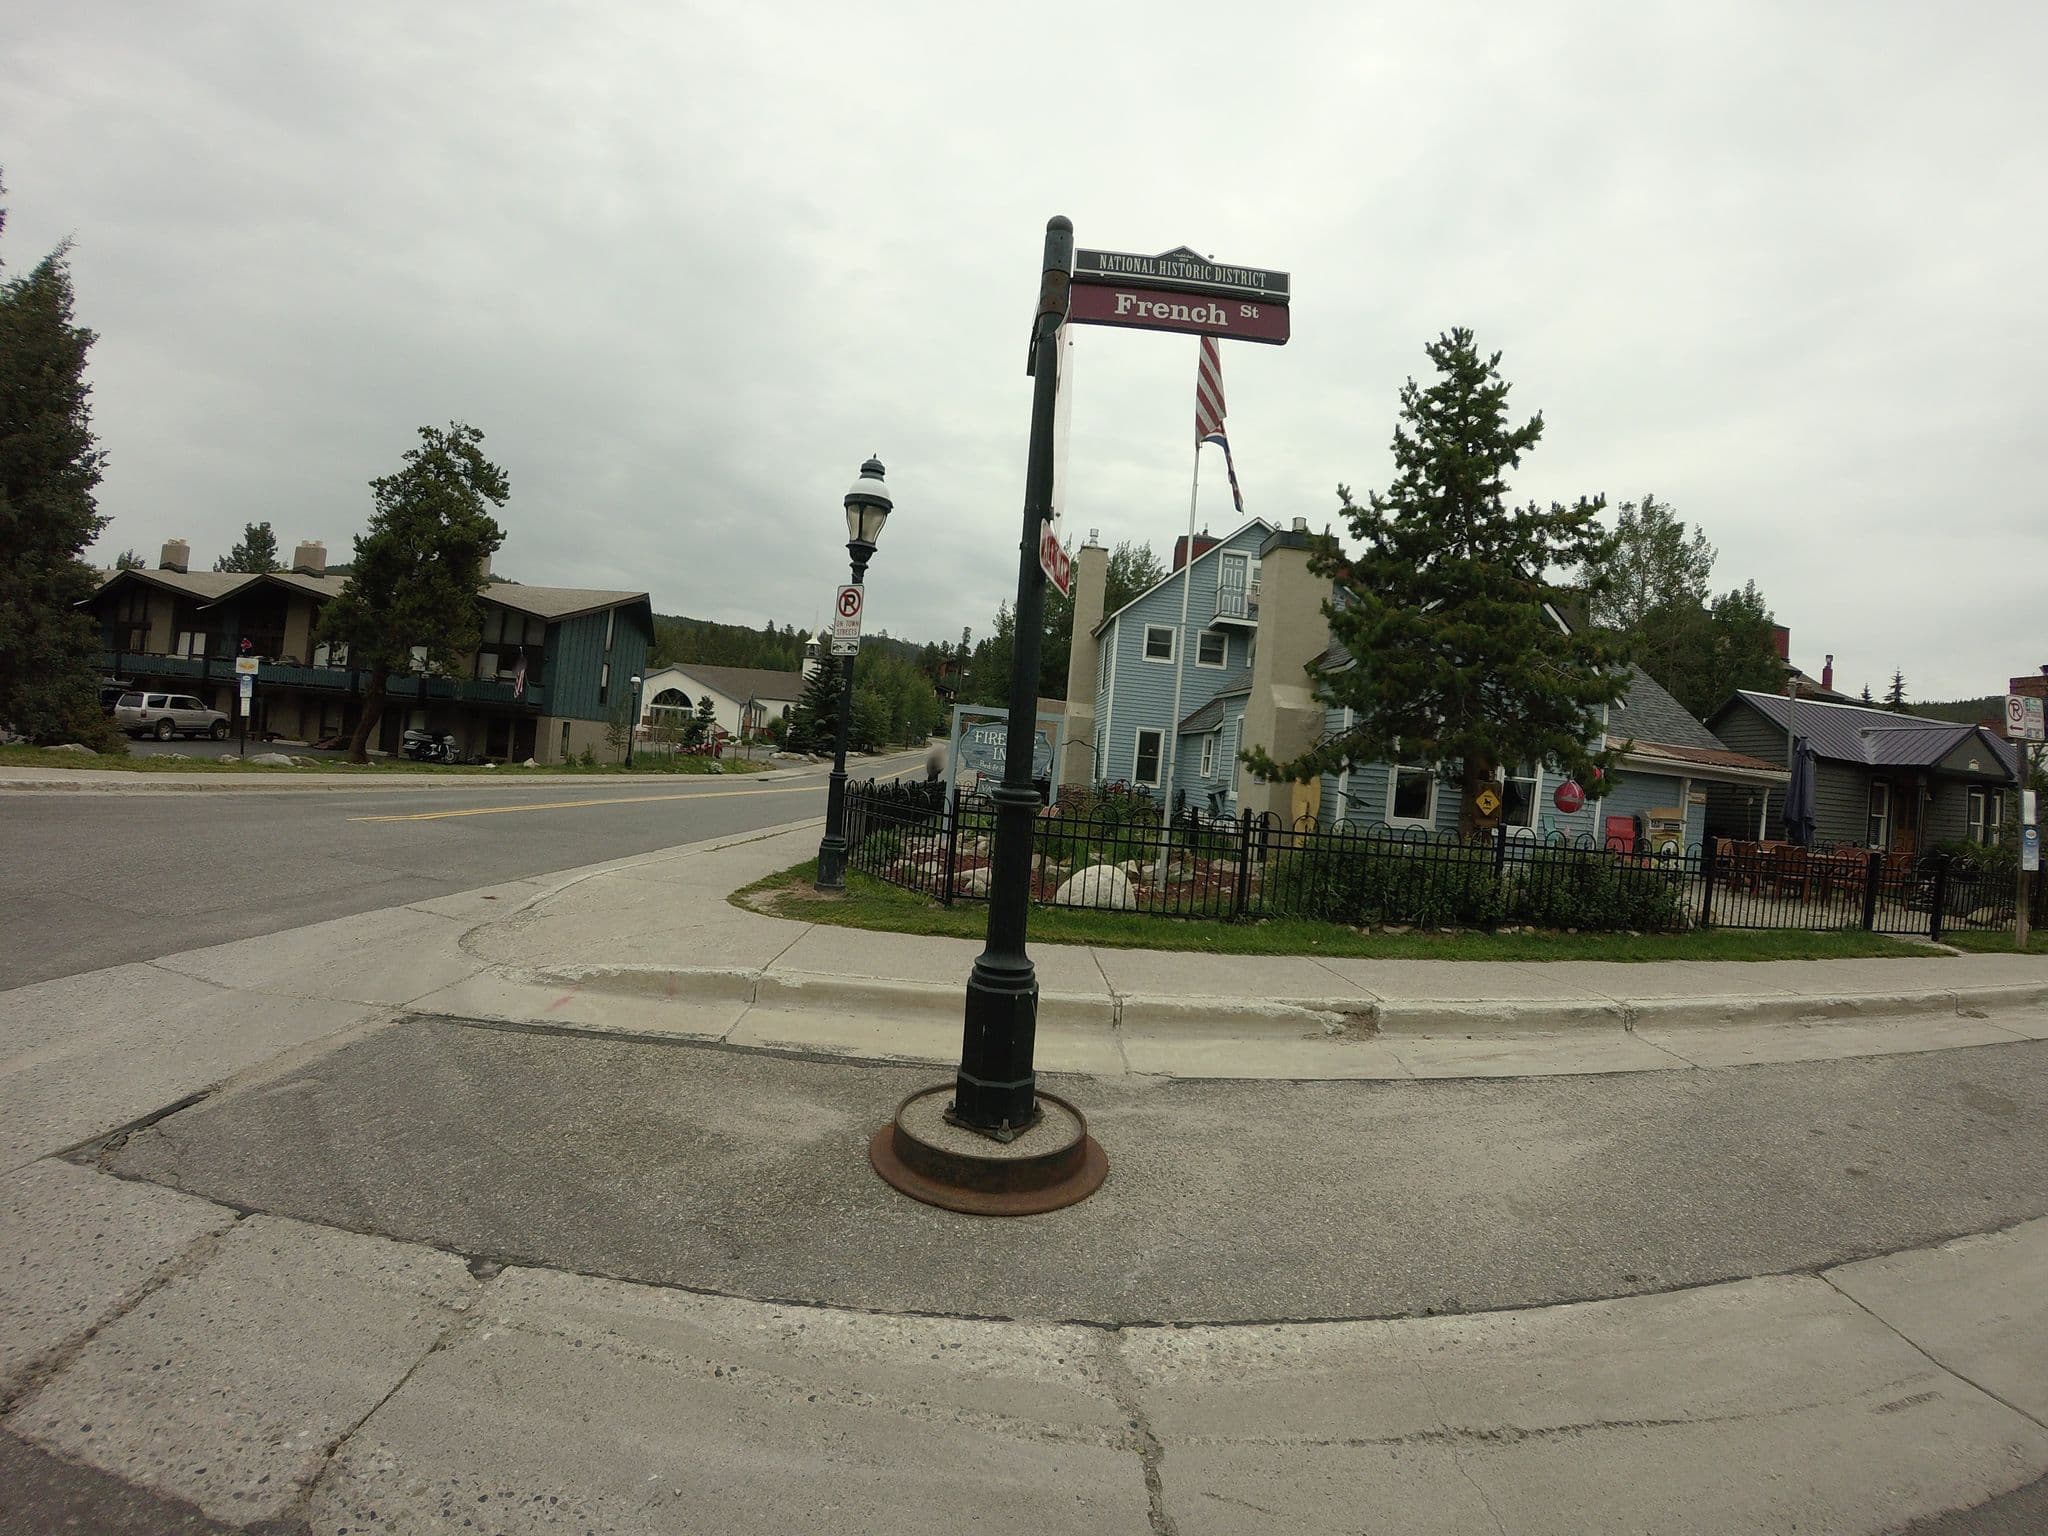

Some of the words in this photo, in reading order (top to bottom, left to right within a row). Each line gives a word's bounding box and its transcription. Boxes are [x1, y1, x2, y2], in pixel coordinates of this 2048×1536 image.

[1100, 254, 1155, 274] NATIONAL
[1159, 260, 1211, 281] HISTORIC
[1215, 267, 1266, 288] DISTRICT
[1114, 293, 1228, 326] French
[1240, 304, 1259, 319] St
[836, 628, 857, 636] STREETS
